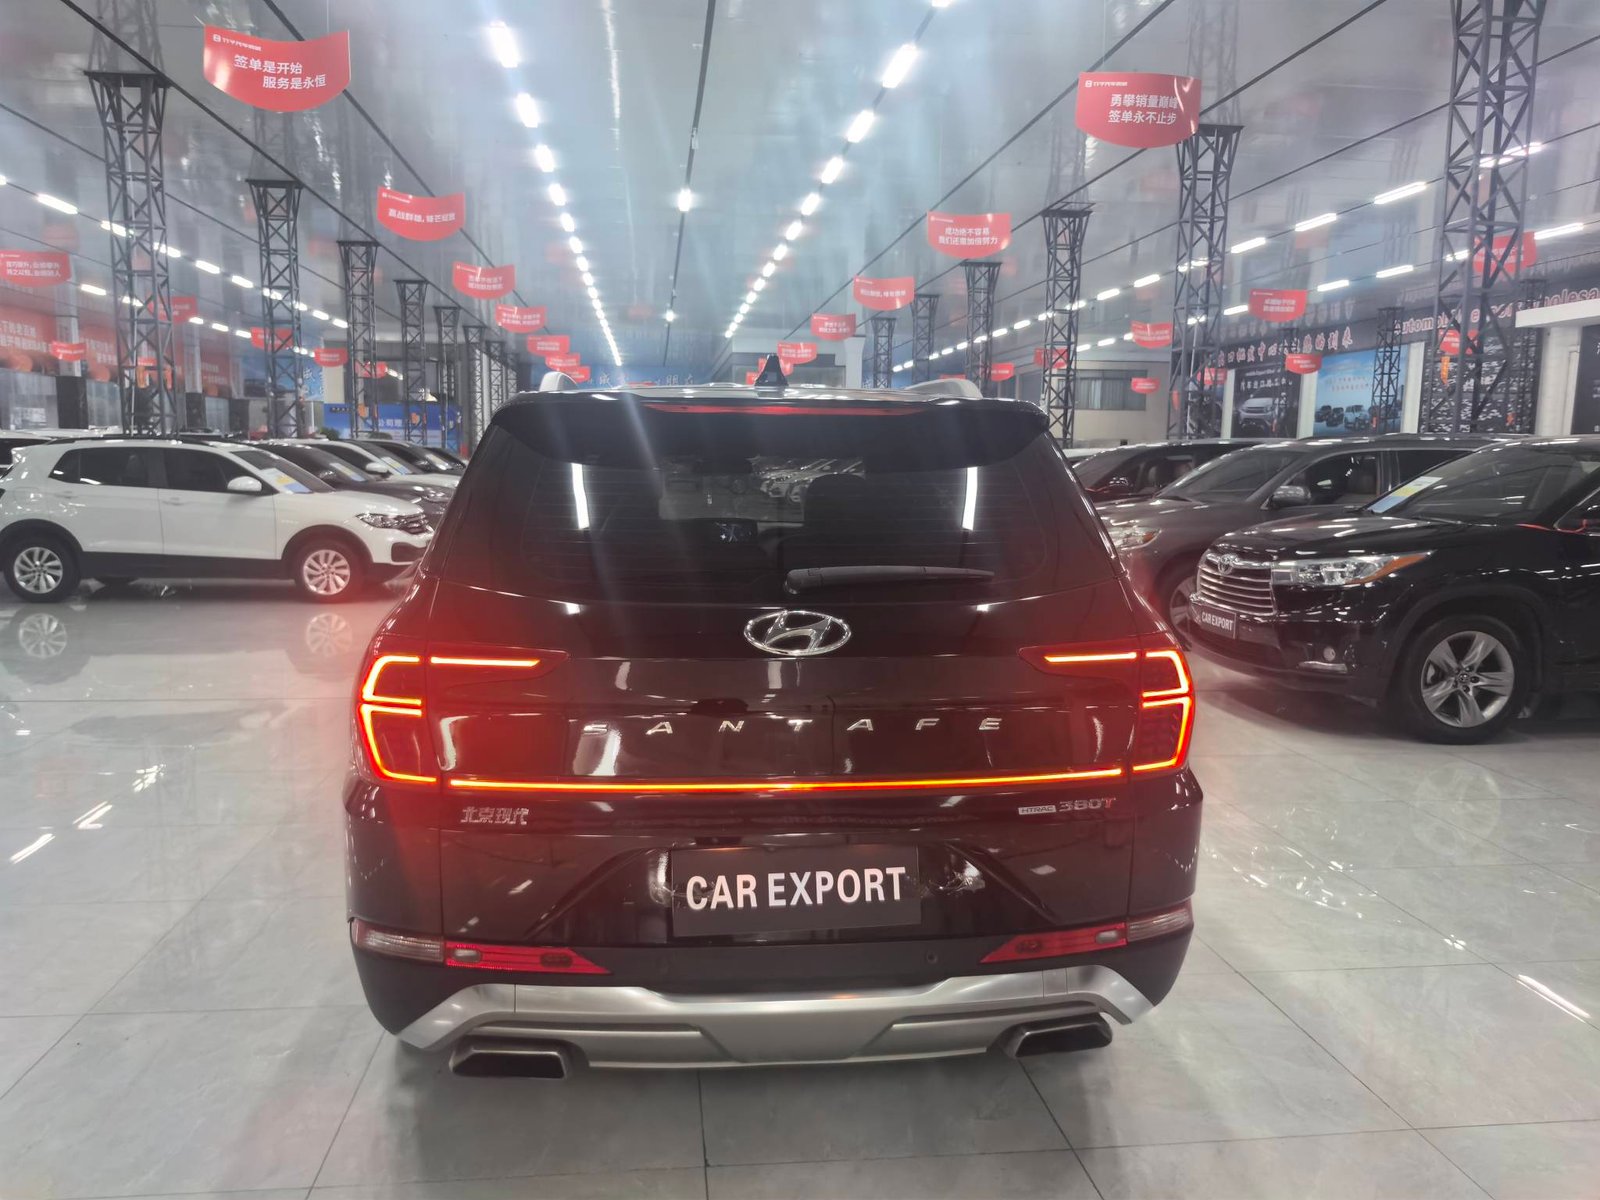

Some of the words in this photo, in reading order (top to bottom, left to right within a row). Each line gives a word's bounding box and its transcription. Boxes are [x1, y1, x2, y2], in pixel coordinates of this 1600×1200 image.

[234, 54, 303, 74] 签单是开始
[262, 74, 327, 90] 服务是永恒
[1110, 93, 1178, 109] 勇攀销量巅峰
[1108, 110, 1177, 125] 签单永不止步
[1201, 611, 1212, 624] CAR
[1211, 614, 1234, 631] EXPORT
[1020, 806, 1056, 815] HTRAC
[1059, 797, 1117, 813] 380T
[460, 806, 530, 826] 北京现代
[686, 874, 758, 911] CAR
[767, 866, 906, 908] EXPORT
